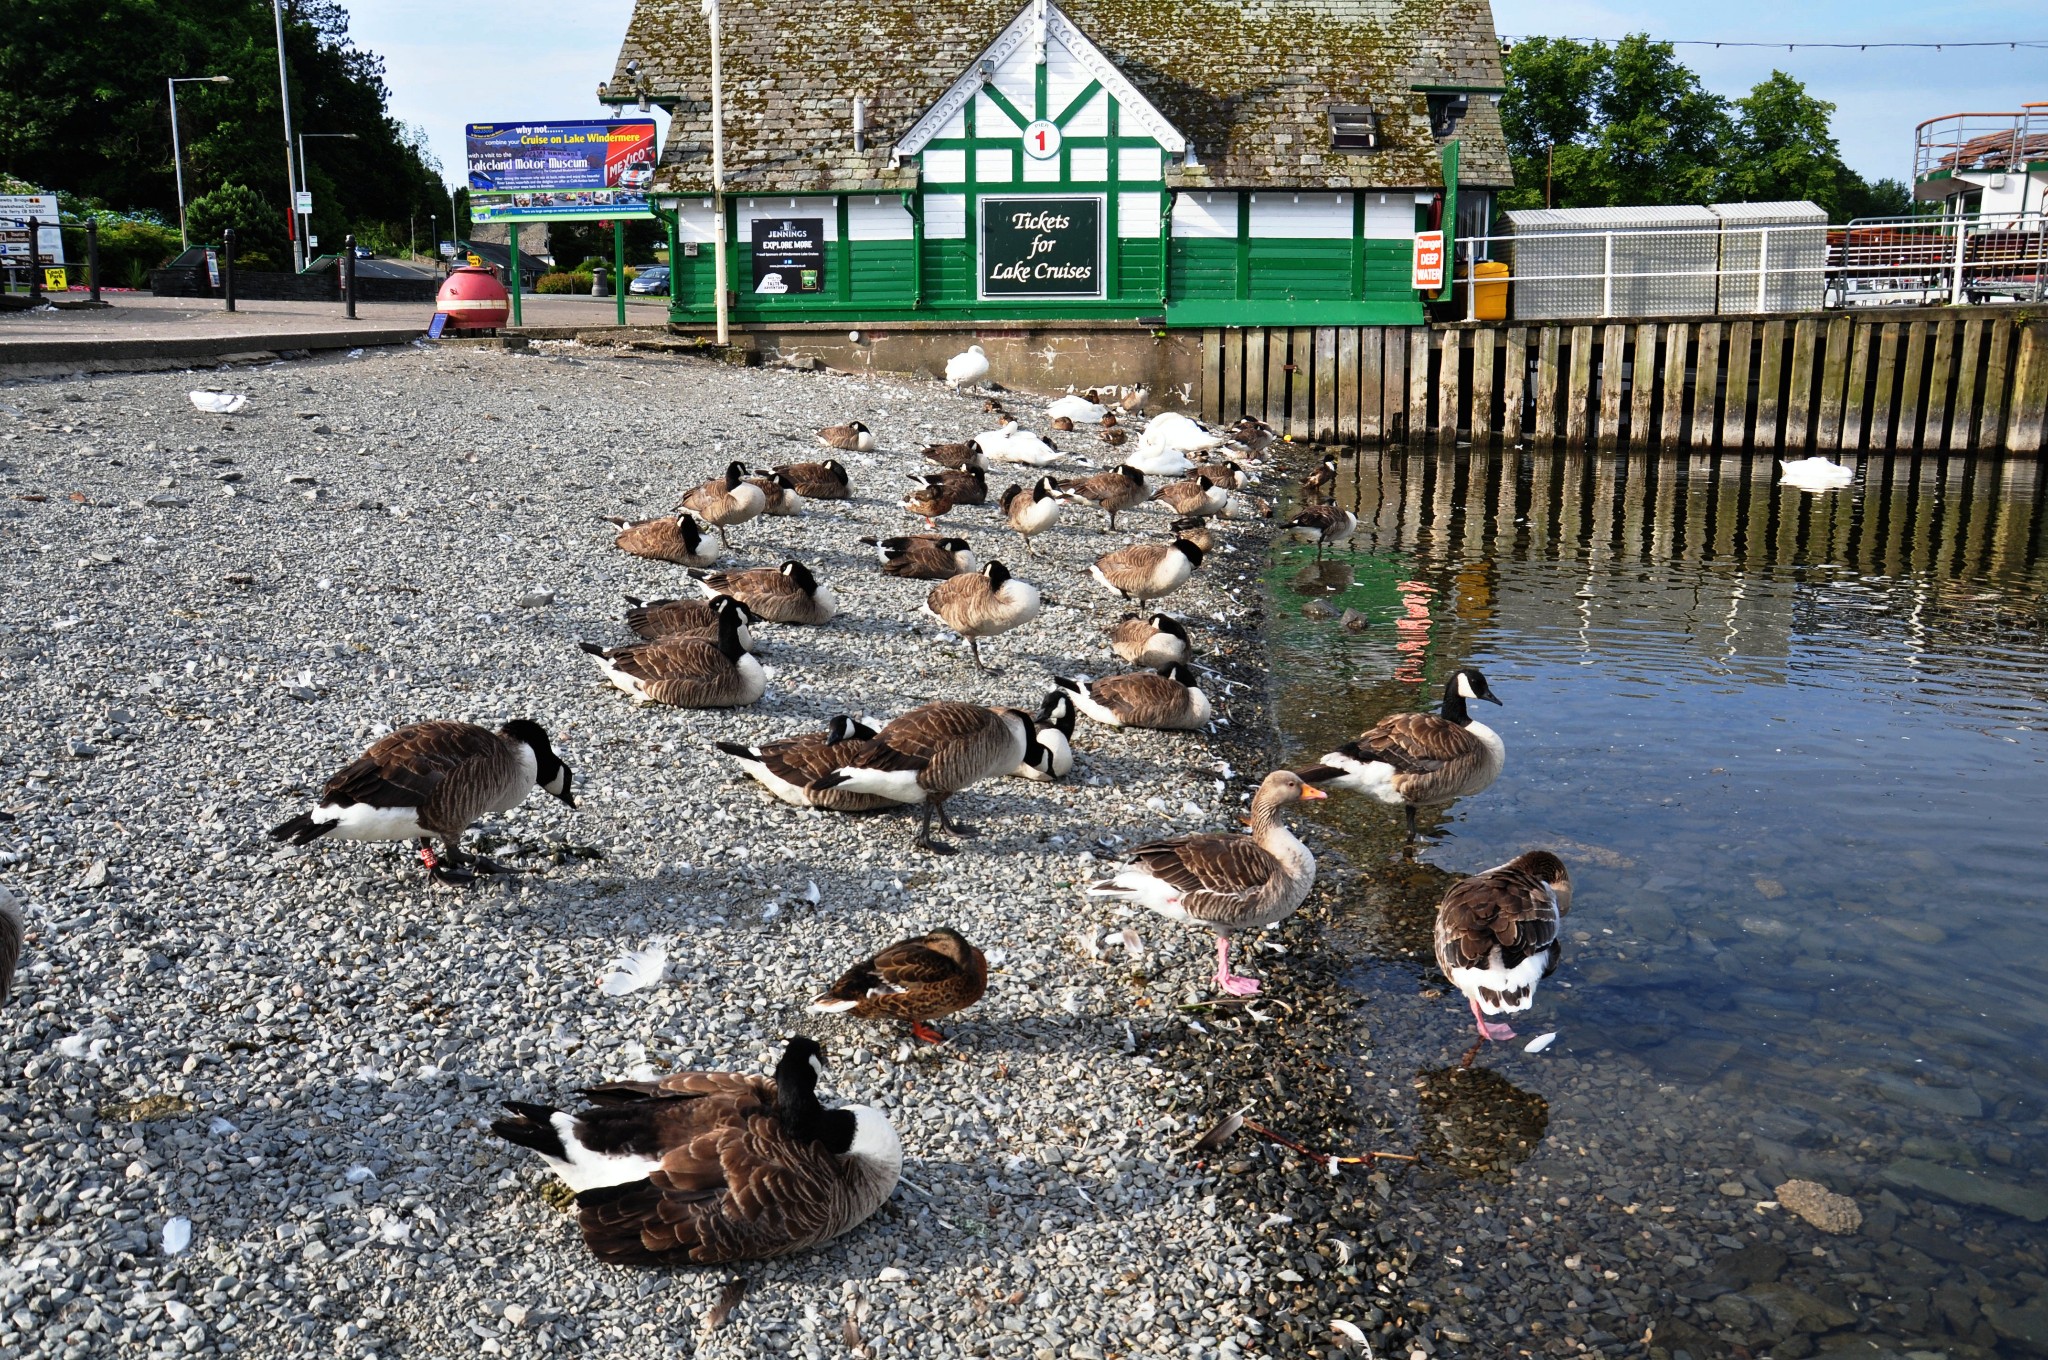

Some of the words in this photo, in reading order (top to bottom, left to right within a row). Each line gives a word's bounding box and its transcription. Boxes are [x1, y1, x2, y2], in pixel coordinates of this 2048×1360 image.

[516, 126, 532, 135] why
[521, 136, 548, 144] Cruise
[564, 134, 584, 143] Lake
[587, 133, 640, 142] Windermere
[1035, 131, 1045, 150] 1
[468, 159, 512, 170] Lakeland
[515, 158, 546, 170] Motor
[549, 158, 588, 168] Museum
[610, 149, 644, 178] MEXICO
[1012, 210, 1070, 232] Tickets
[763, 241, 793, 250] EXPLORE
[794, 241, 812, 250] MORE
[1026, 234, 1056, 259] for
[1418, 239, 1440, 250] Danger
[1421, 253, 1439, 265] DEEP
[990, 261, 1030, 282] Lake
[1034, 262, 1092, 279] Cruises
[1418, 269, 1440, 280] WATER
